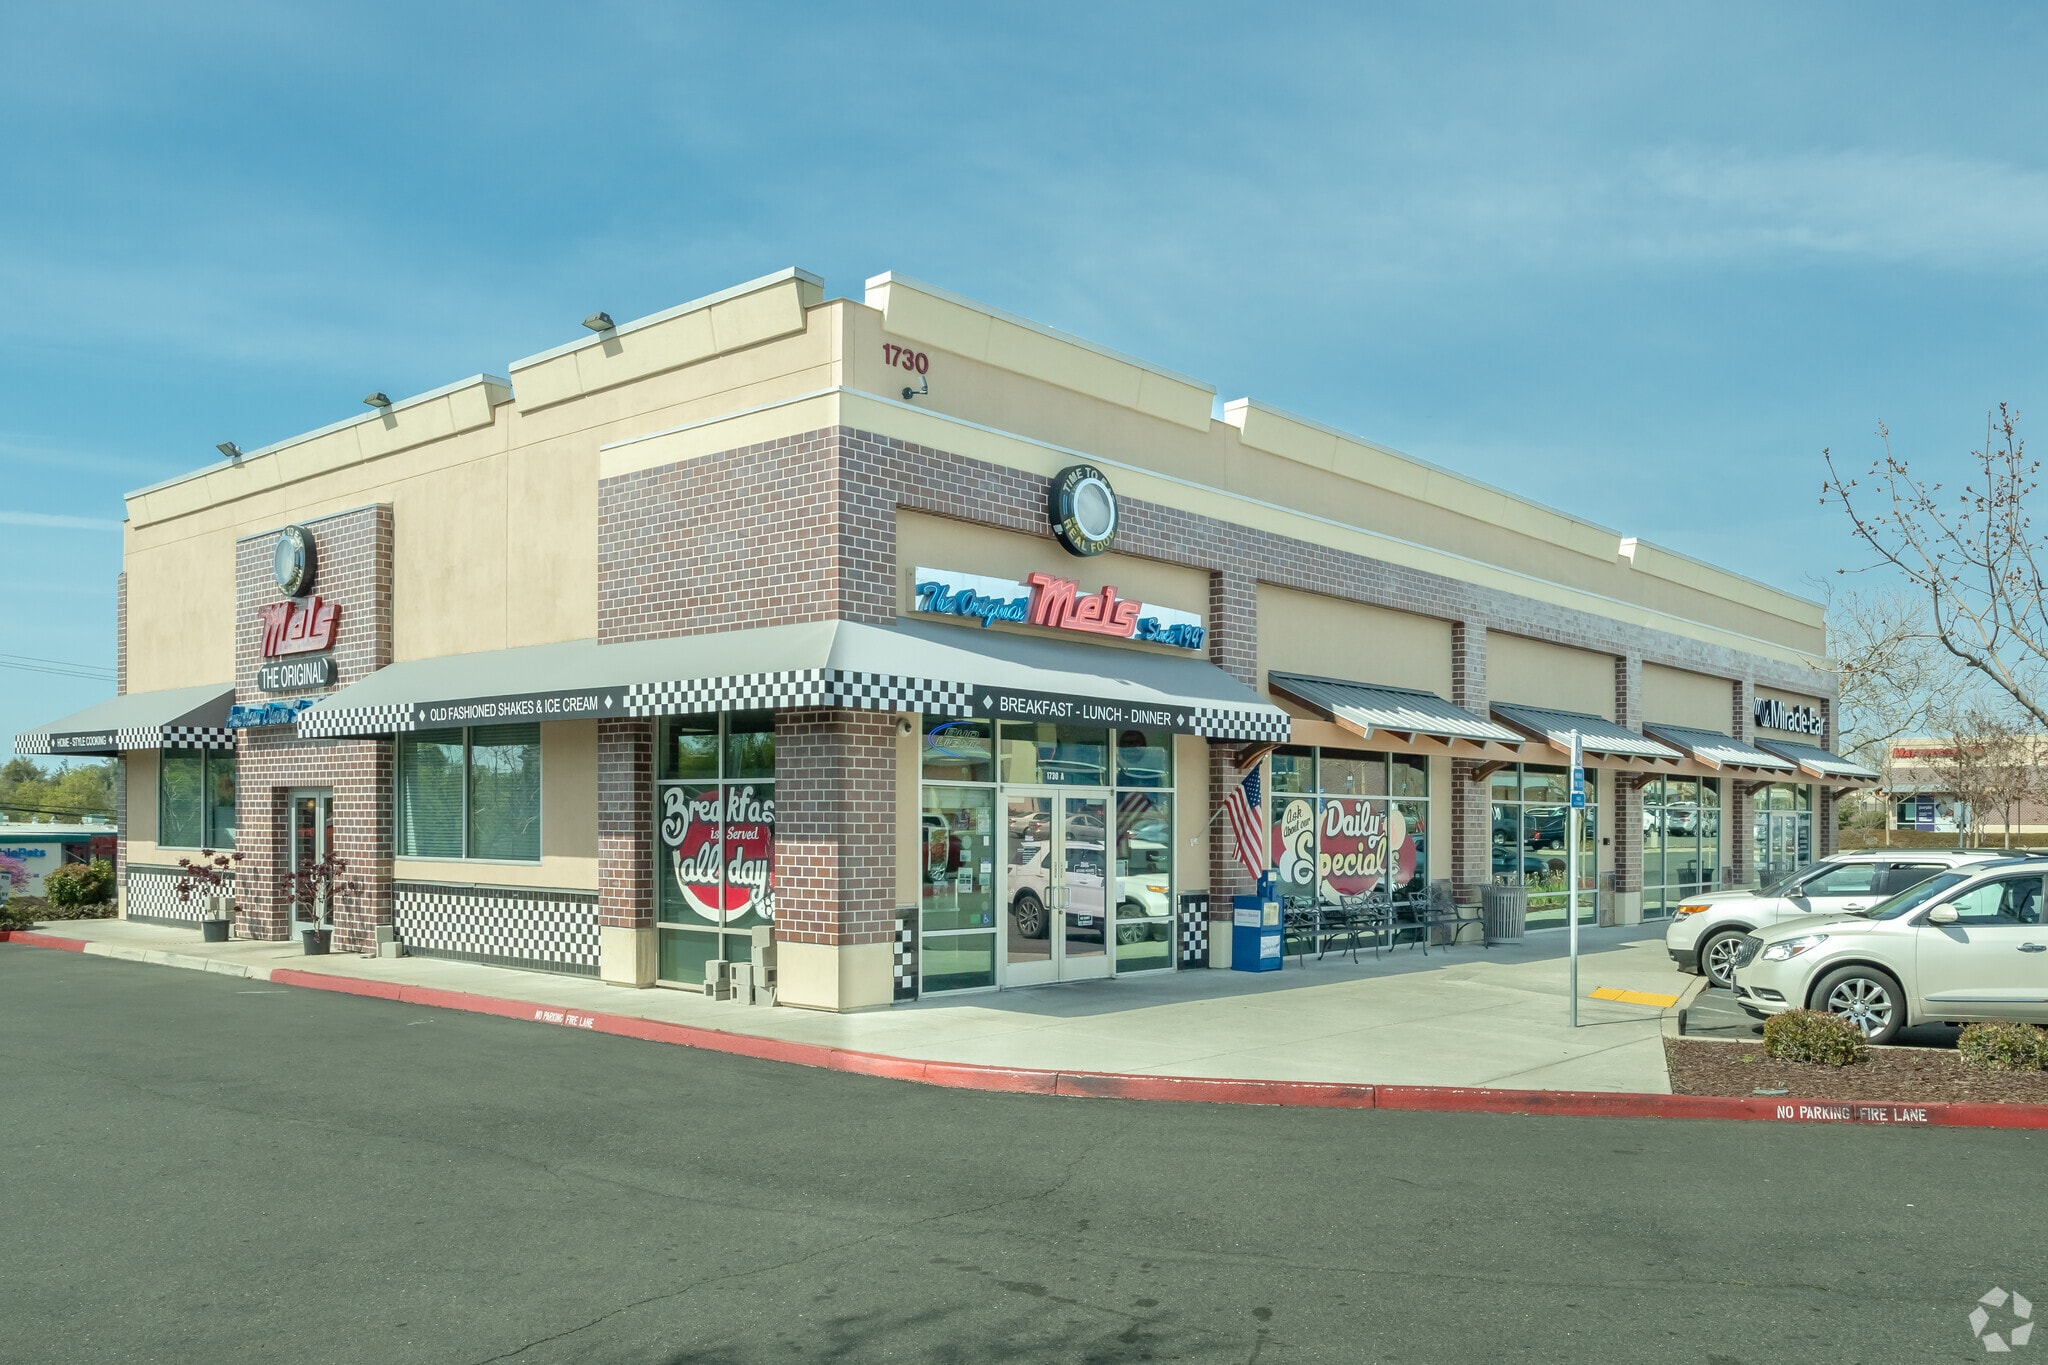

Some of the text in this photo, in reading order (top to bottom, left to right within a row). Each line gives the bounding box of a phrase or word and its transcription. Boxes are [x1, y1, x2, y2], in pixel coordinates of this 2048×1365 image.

[883, 343, 929, 375] 1730
[1063, 467, 1083, 492] TIME
[1085, 467, 1098, 478] TO
[1064, 517, 1087, 551] REAL
[921, 572, 1206, 649] The Original Mels Since 1947
[258, 596, 340, 657] Mels
[262, 661, 325, 689] THE ORIGINAL
[430, 696, 598, 721] OLD FASHIONED SHAKES & ICE CREAM
[1000, 696, 1073, 717] BREAKFAST
[1083, 704, 1122, 721] LUNCH
[1131, 709, 1171, 726] DINNER
[1771, 700, 1825, 735] Miracle-Ear
[86, 736, 106, 746] COOKING
[662, 786, 775, 846] Breakfas
[1287, 805, 1302, 824] Ask
[1326, 800, 1385, 849] Daily
[710, 826, 759, 840] is Served
[681, 842, 767, 901] all day
[535, 1009, 594, 1028] NO PARKING FIRE LANE
[1777, 1105, 1927, 1122] NO PARKING FIRE LANE
